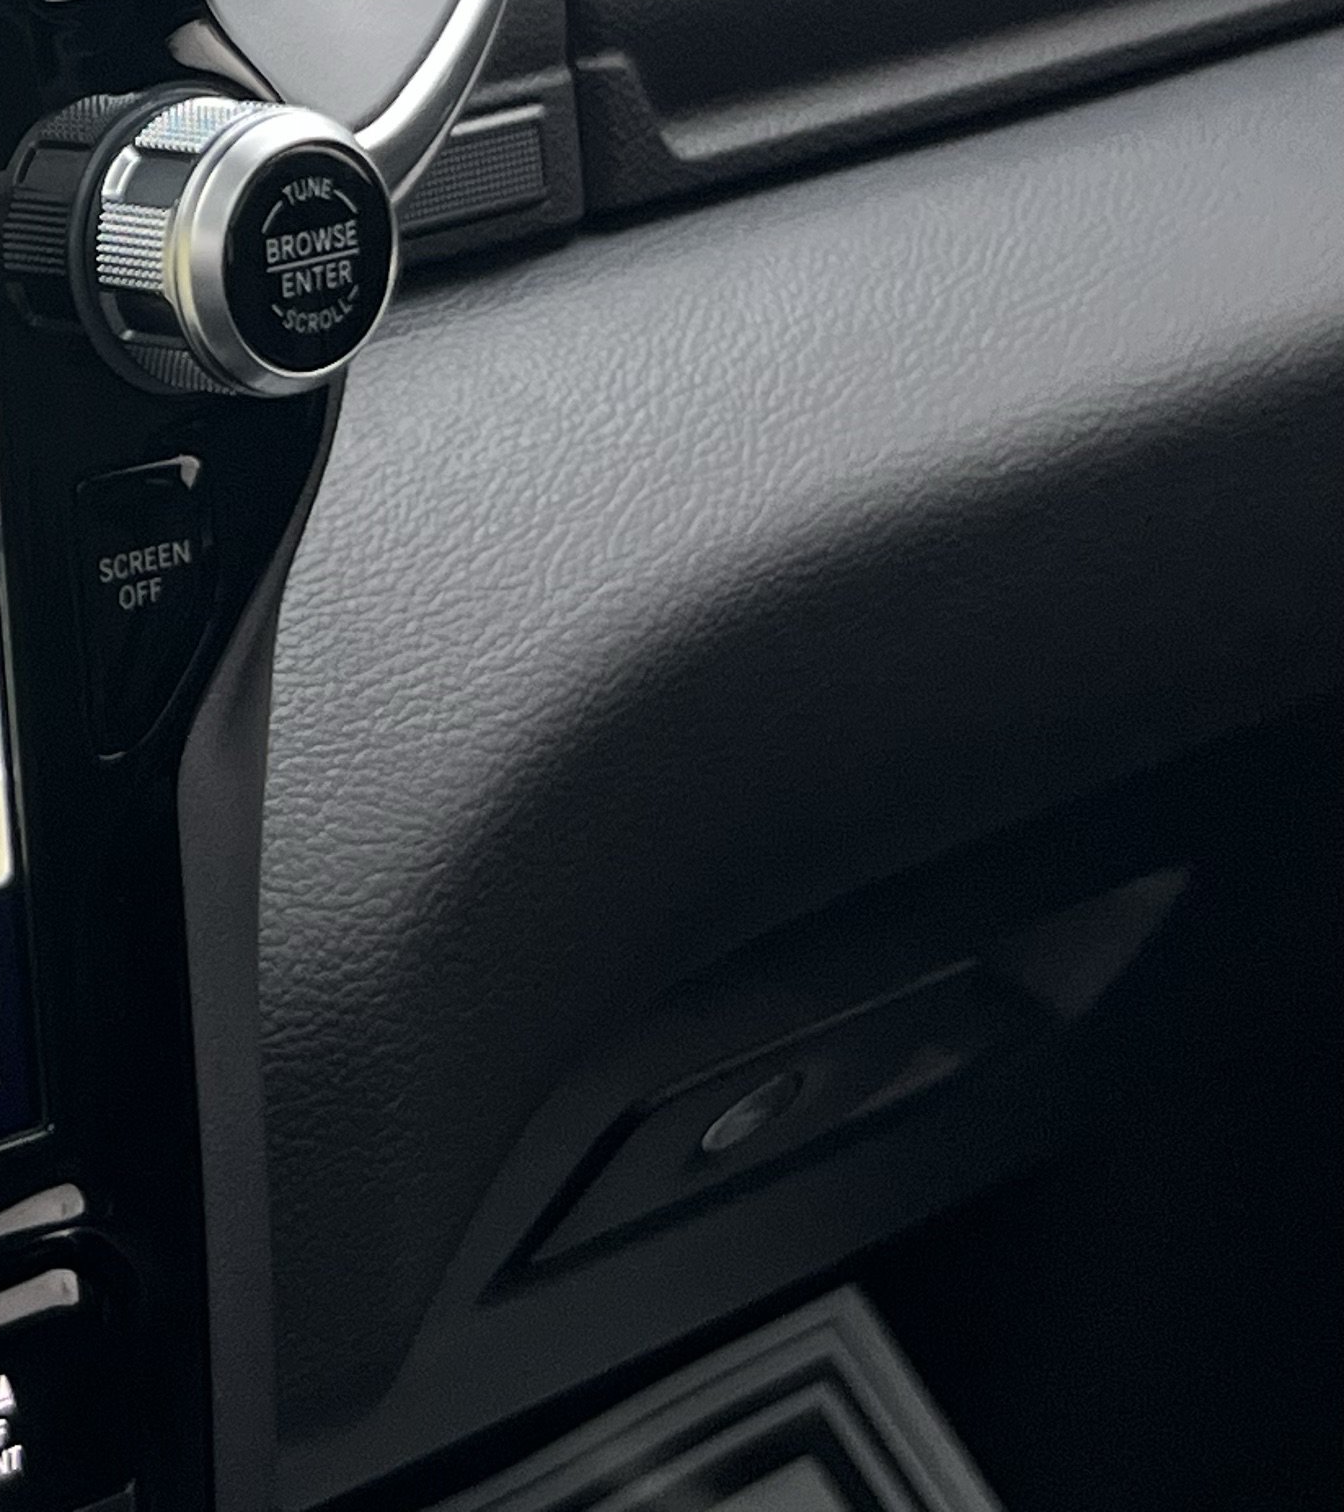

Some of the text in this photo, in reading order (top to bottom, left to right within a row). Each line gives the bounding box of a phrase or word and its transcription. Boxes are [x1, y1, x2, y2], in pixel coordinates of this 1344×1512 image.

[281, 176, 334, 206] TUNE
[265, 219, 358, 265] BROWSE
[281, 259, 353, 299] ENTER
[281, 296, 353, 334] SCROLL
[98, 538, 193, 584] SCREEN
[118, 576, 163, 611] OFF
